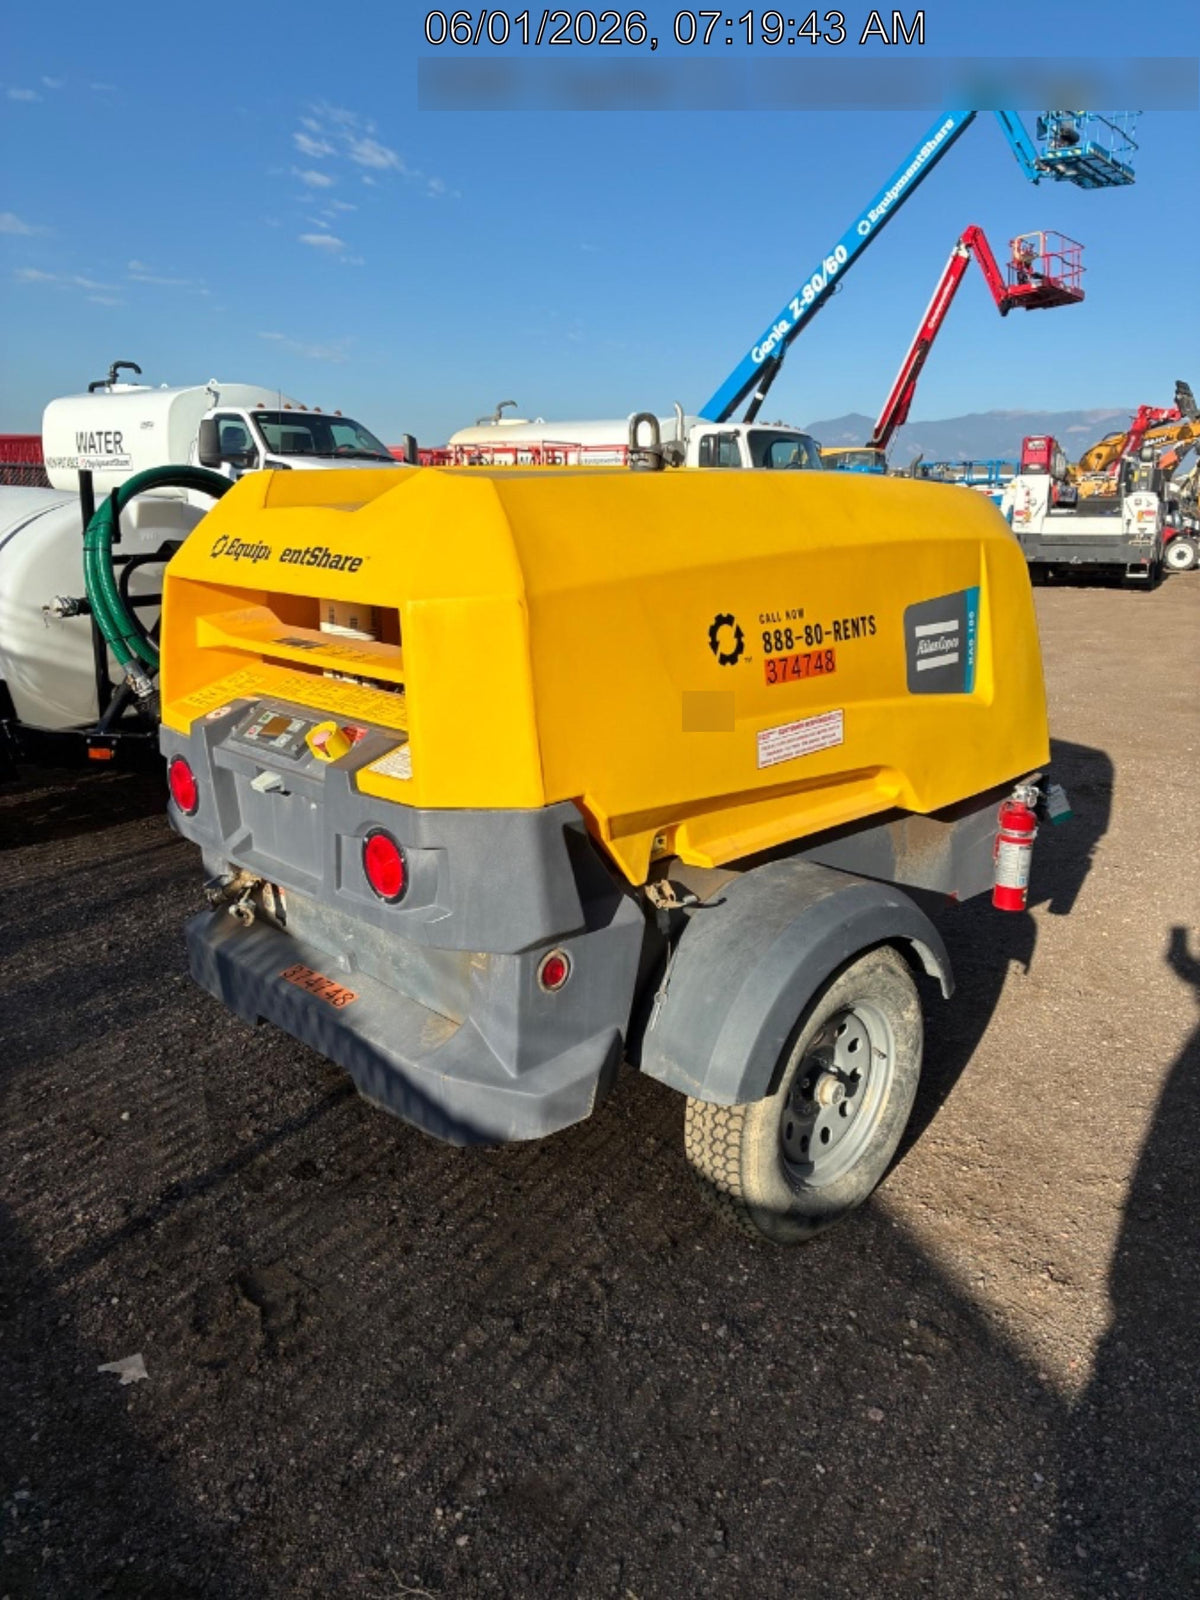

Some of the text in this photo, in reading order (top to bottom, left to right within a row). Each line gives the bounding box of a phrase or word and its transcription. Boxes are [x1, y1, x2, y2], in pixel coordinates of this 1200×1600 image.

[868, 118, 954, 223] EquipmentShare
[751, 245, 848, 364] Genie Z-80/60
[75, 431, 124, 454] WATER
[759, 608, 805, 625] CALL NOW
[762, 615, 877, 654] 888-80-RENTS
[767, 650, 836, 684] 374748
[282, 965, 355, 1007] 374748
